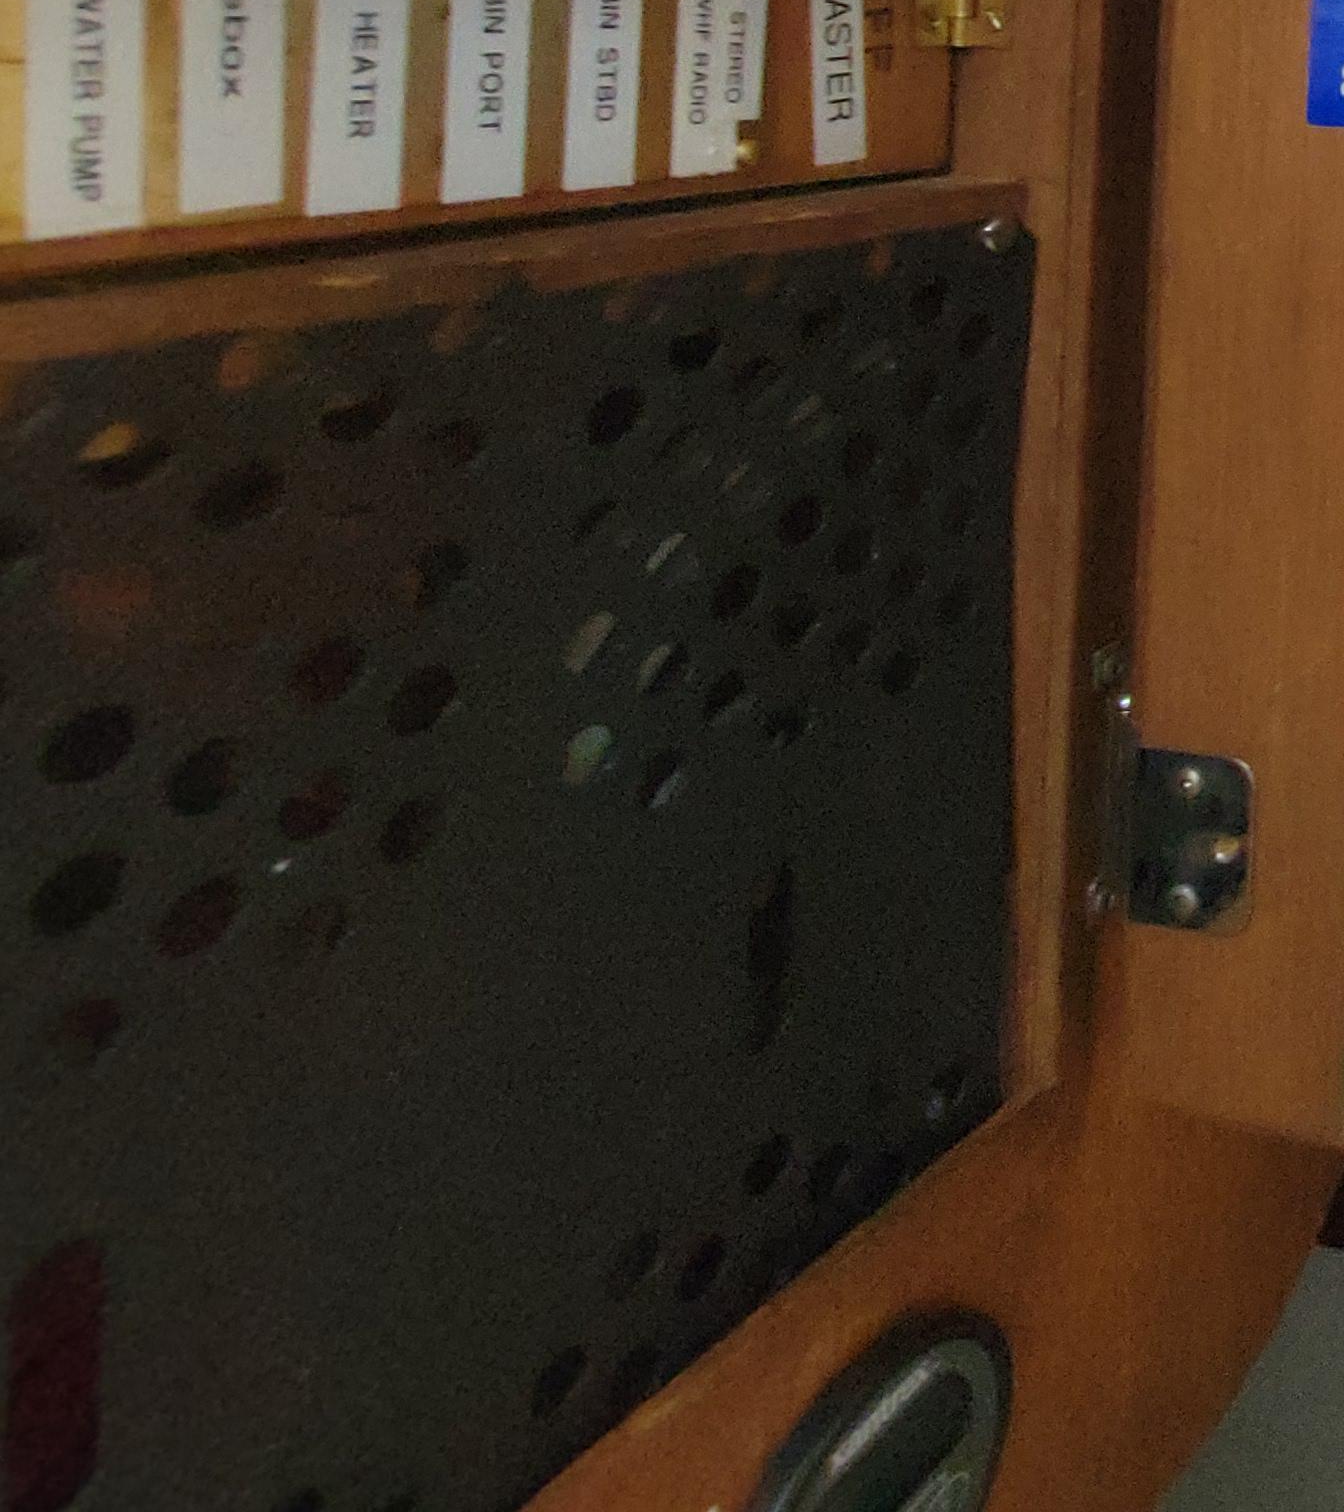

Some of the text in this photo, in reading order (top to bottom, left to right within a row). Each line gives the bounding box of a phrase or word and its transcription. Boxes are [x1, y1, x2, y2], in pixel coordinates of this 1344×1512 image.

[347, 10, 381, 139] HEATER
[476, 51, 507, 132] PORT
[594, 46, 622, 123] STBD
[687, 52, 711, 126] RADIO
[69, 114, 106, 203] PUMP
